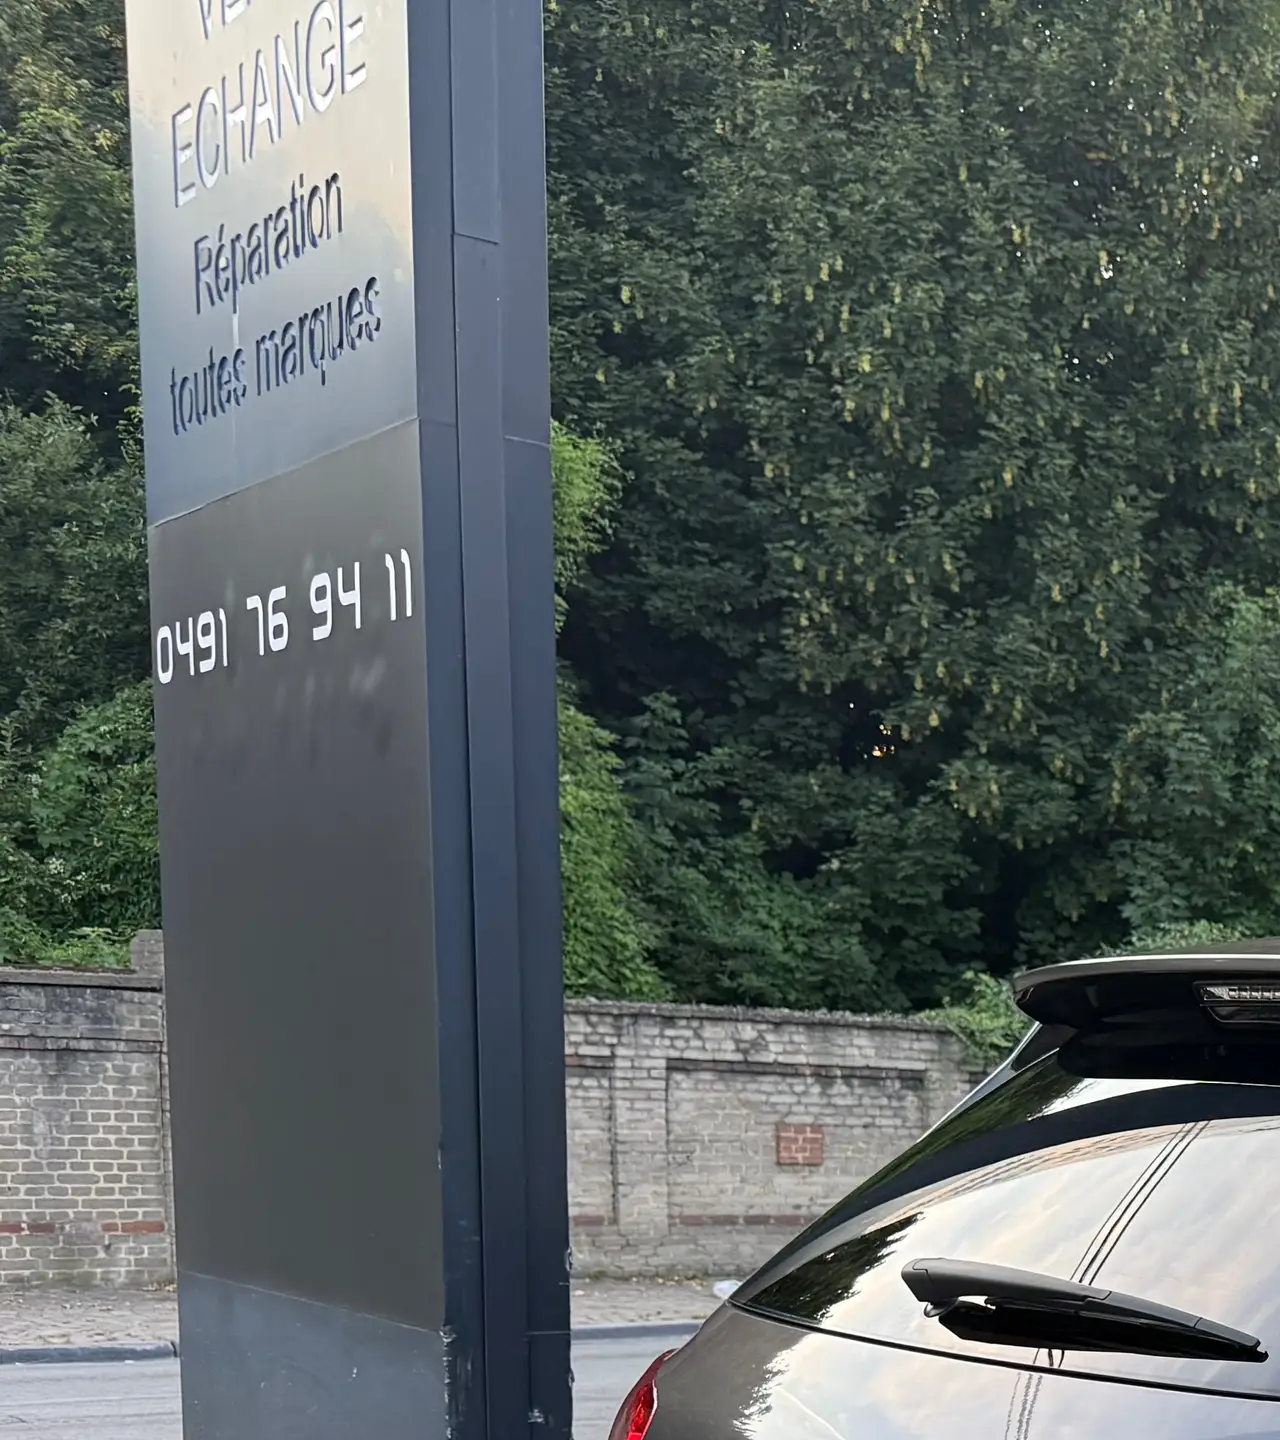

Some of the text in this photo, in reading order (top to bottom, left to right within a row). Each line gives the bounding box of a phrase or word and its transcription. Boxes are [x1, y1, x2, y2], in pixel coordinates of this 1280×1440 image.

[171, 0, 368, 208] ECHANGE
[193, 172, 343, 315] Réparation
[170, 276, 382, 435] toutes marques
[156, 548, 413, 685] 0491 76 94 11
